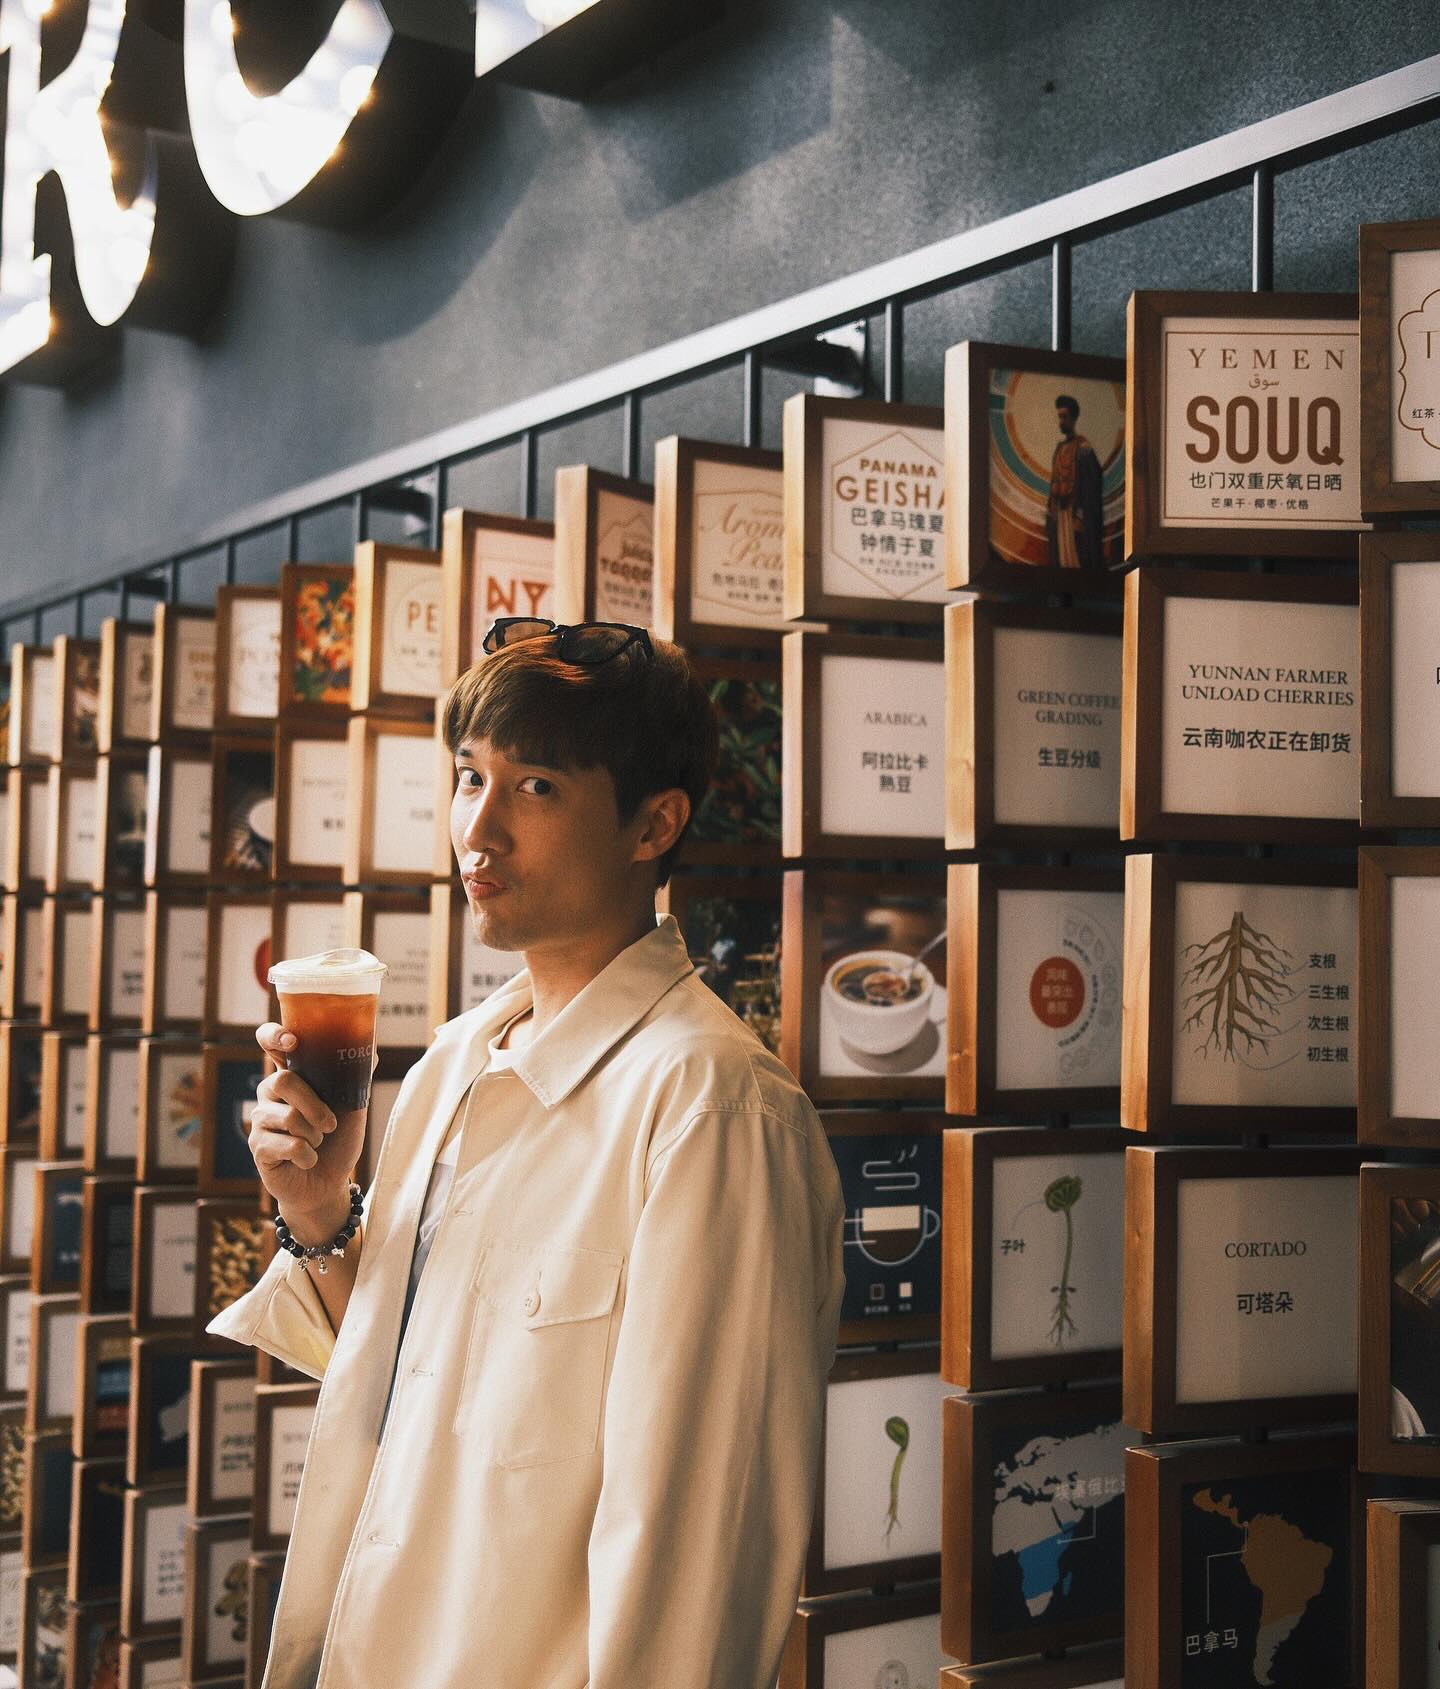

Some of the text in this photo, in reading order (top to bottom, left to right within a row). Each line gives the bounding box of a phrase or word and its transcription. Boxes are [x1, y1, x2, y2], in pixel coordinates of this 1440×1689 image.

[1187, 348, 1345, 370] YEMEN
[1185, 395, 1344, 466] SOUQ
[859, 458, 938, 479] PANAMA
[1189, 472, 1342, 491] 也门双重厌氧日晒
[1188, 664, 1348, 686] YUNNAN FARMER
[1017, 689, 1066, 705] GREEN
[1182, 685, 1354, 707] UNLOAD CHERRIES
[863, 711, 928, 727] ARABICA
[1035, 709, 1102, 727] GRADING
[1183, 727, 1351, 753] 云南咖农正在卸货
[862, 751, 928, 771] 阿拉比卡
[1308, 953, 1336, 969] 支根
[1308, 984, 1349, 1001] 三生根
[1308, 1015, 1349, 1032] 次生根
[1307, 1046, 1349, 1063] 初生根
[1225, 1240, 1307, 1259] CORTADO
[1236, 1291, 1294, 1315] 可塔朵
[1186, 1628, 1239, 1656] 巴拿马
